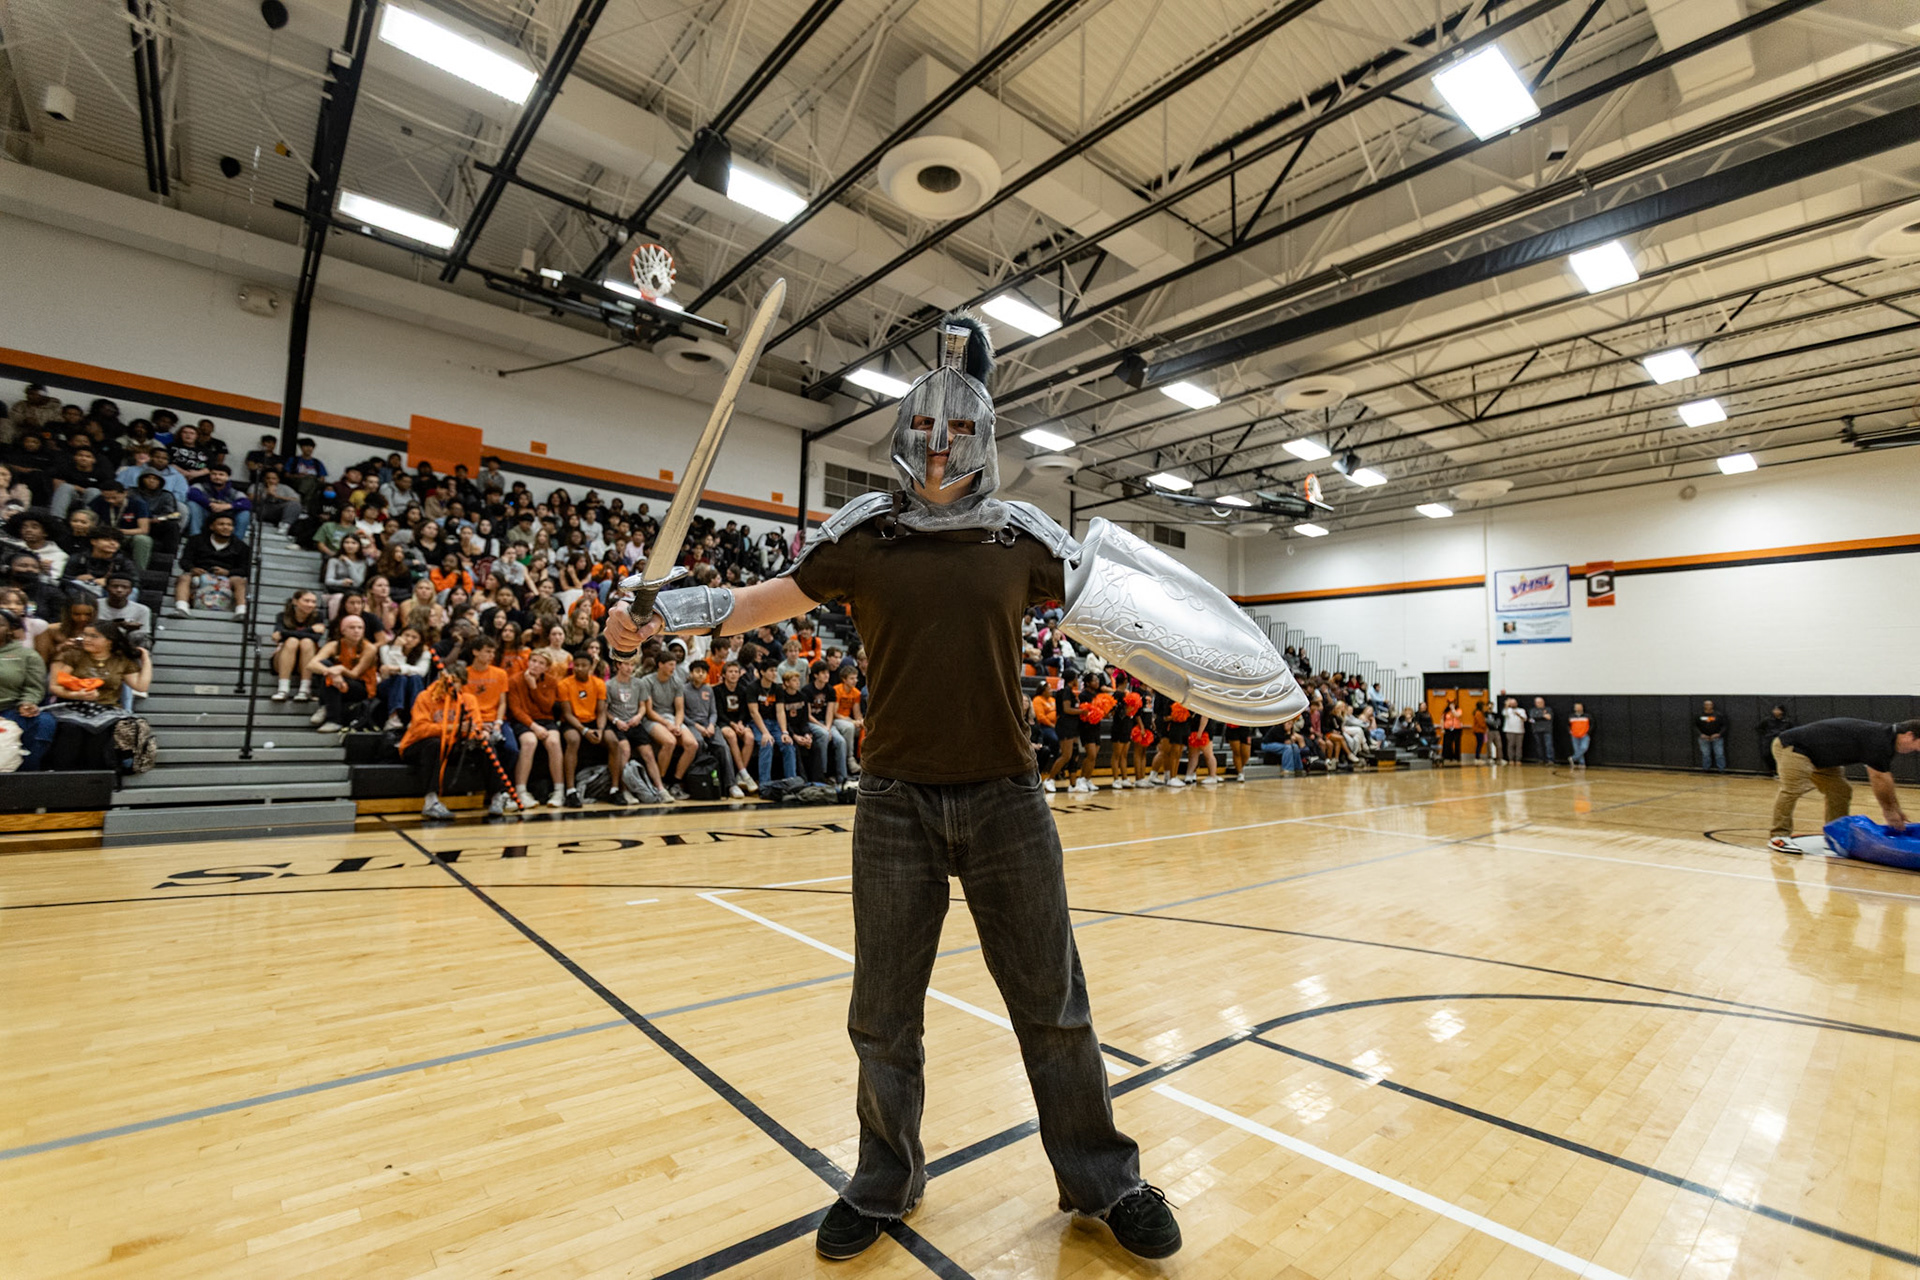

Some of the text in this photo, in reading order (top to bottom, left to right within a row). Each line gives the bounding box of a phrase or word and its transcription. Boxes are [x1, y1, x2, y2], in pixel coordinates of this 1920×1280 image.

[1510, 574, 1553, 595] VHSL
[1591, 575, 1611, 593] C
[152, 824, 852, 889] KNIGHTS
